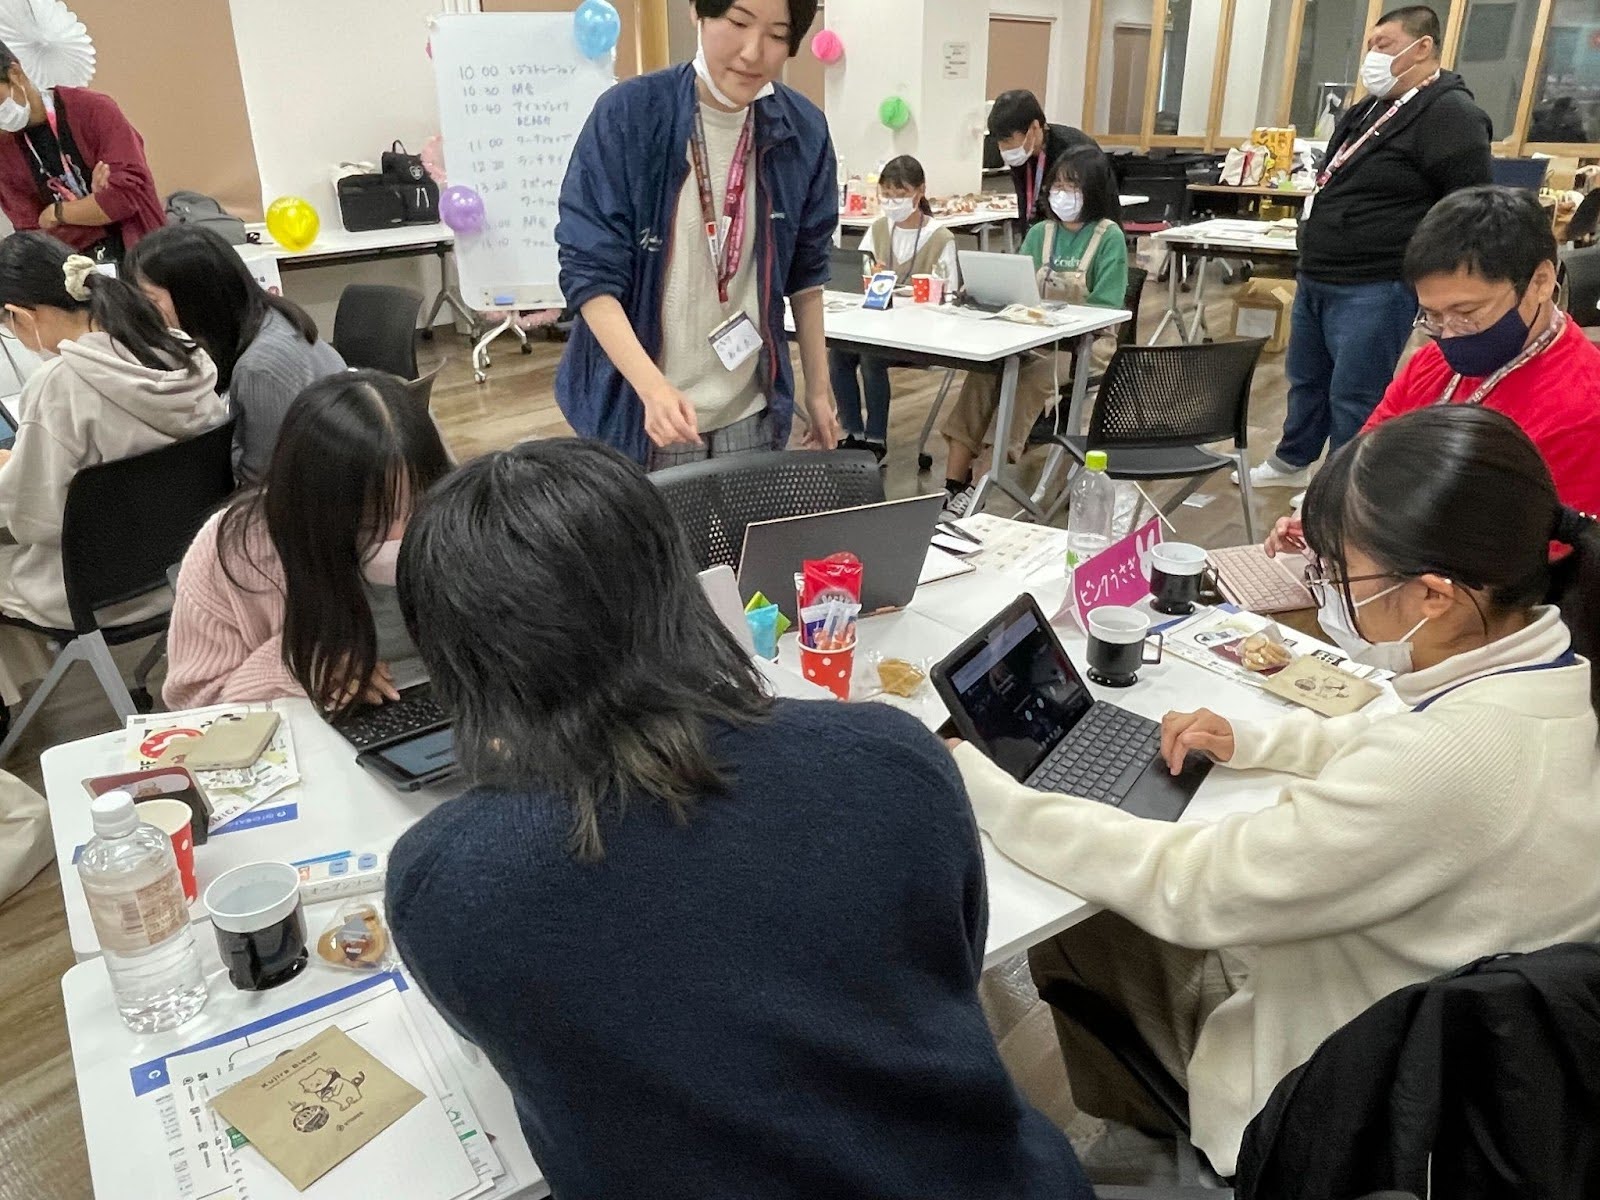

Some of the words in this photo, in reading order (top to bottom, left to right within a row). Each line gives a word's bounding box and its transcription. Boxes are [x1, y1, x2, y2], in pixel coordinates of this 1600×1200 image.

[1080, 556, 1136, 607] ピンクうさぎ
